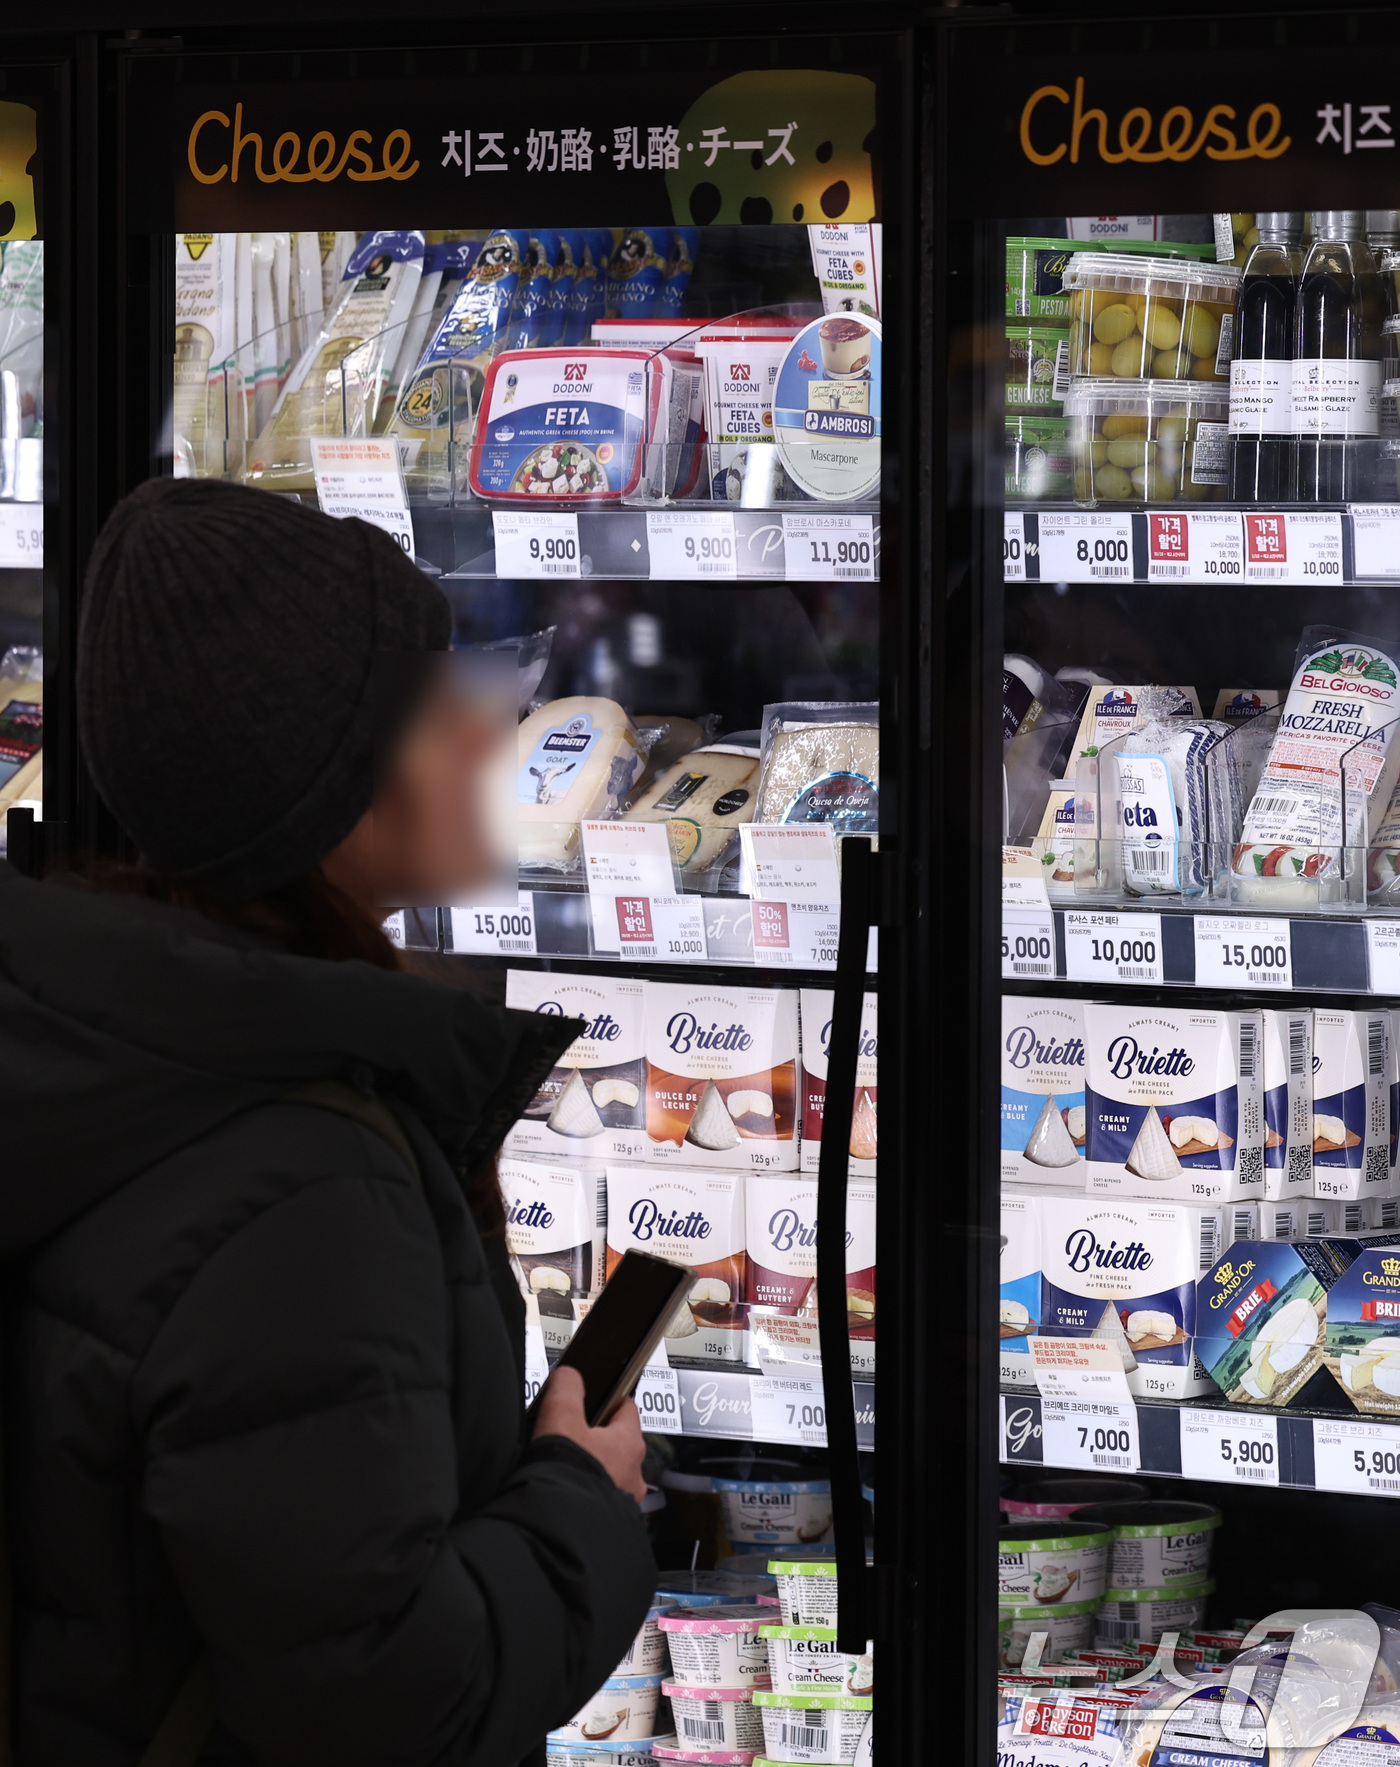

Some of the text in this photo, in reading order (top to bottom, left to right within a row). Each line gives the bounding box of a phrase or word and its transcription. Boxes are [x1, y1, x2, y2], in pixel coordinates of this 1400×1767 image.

[1020, 76, 1292, 166] Cheese
[188, 102, 420, 184] Cheese
[828, 258, 848, 268] FETA
[827, 269, 853, 280] CUBES
[553, 383, 593, 393] DODONI
[724, 383, 760, 392] DODONI
[411, 392, 432, 411] 24
[545, 407, 590, 425] FETA
[731, 410, 755, 421] FETA
[727, 422, 760, 433] CUBES
[820, 416, 871, 434] AMBROSI
[810, 449, 859, 465] Mascarpone
[786, 518, 851, 527] 암브로시 마스카포네
[1042, 516, 1112, 525] 자이언트 그린 올리브
[1157, 517, 1181, 533] 가격
[1254, 519, 1278, 535] 가격
[1158, 533, 1181, 550] 할인
[1255, 536, 1279, 552] 할인
[530, 538, 576, 562] 9,900
[684, 537, 732, 561] 9,900
[810, 541, 870, 566] 11,900
[1077, 539, 1128, 565] 8,000
[1204, 561, 1240, 575] 10,000
[1303, 561, 1339, 575] 10,000
[1097, 704, 1136, 714] ILE FRANCE
[1311, 700, 1364, 719] FRESH
[1098, 720, 1131, 728] CHAVROUX
[1279, 714, 1386, 743] MOZZARELLA
[548, 736, 587, 747] BEEMSTER
[1313, 735, 1347, 743] FAVORITE
[546, 756, 568, 764] GOAT
[1122, 801, 1157, 827] eta
[622, 901, 644, 916] 가격
[759, 906, 781, 920] 50%
[474, 914, 532, 938] 15,000
[623, 916, 646, 932] 할인
[1068, 915, 1119, 926] 루사스 포션 페타
[1254, 922, 1269, 931] 로그
[760, 923, 782, 937] 할인
[668, 941, 702, 955] 10,000
[1091, 939, 1156, 965] 10,000
[1222, 945, 1287, 970] 15,000
[687, 996, 738, 1009] ALWAYS CREAMY
[1026, 1010, 1076, 1023] ALWAYS CREAMY
[1128, 1019, 1179, 1032] ALWAYS CREAMY
[666, 1012, 754, 1054] Briette
[1107, 1036, 1196, 1079] Briette
[655, 1091, 697, 1101] DULCE DE
[662, 1101, 690, 1111] LECHE
[1006, 1112, 1026, 1120] BLUE
[1099, 1115, 1130, 1124] CREAMY
[1108, 1123, 1127, 1132] MILD
[517, 1172, 540, 1187] CREAMY
[648, 1184, 697, 1197] ALWAYS CREAMY
[629, 1199, 712, 1240] Briette
[1086, 1212, 1138, 1226] ALWAYS CREAMY
[511, 1230, 531, 1238] CHEESE
[1065, 1229, 1154, 1273] Briette
[756, 1285, 787, 1294] CREAMY
[1209, 1260, 1256, 1310] GRAND'OR
[757, 1294, 792, 1303] BUTTERY
[1057, 1307, 1088, 1317] CREAMY
[1234, 1290, 1263, 1322] BRIE
[1065, 1317, 1085, 1326] MILD
[753, 1379, 813, 1391] 크리미 버터리 레드
[1044, 1401, 1119, 1415] 브리에뜨 크리미 마일드
[1373, 1402, 1394, 1410] weight
[1185, 1412, 1264, 1427] 그랑도르 까망베르 치즈
[1318, 1423, 1382, 1436] 그랑도르 브리 치즈
[1077, 1427, 1130, 1452] 7,000
[1221, 1439, 1274, 1464] 5,900
[741, 1492, 791, 1505] Le Gall
[741, 1523, 794, 1532] Cream Cheese
[1166, 1535, 1184, 1549] Le
[1162, 1567, 1187, 1577] Cream
[1002, 1584, 1030, 1593] Cheese
[739, 1665, 767, 1674] Cream
[788, 1673, 844, 1683] Cream Cheese
[1169, 1752, 1251, 1767] CREAM CHEESE
